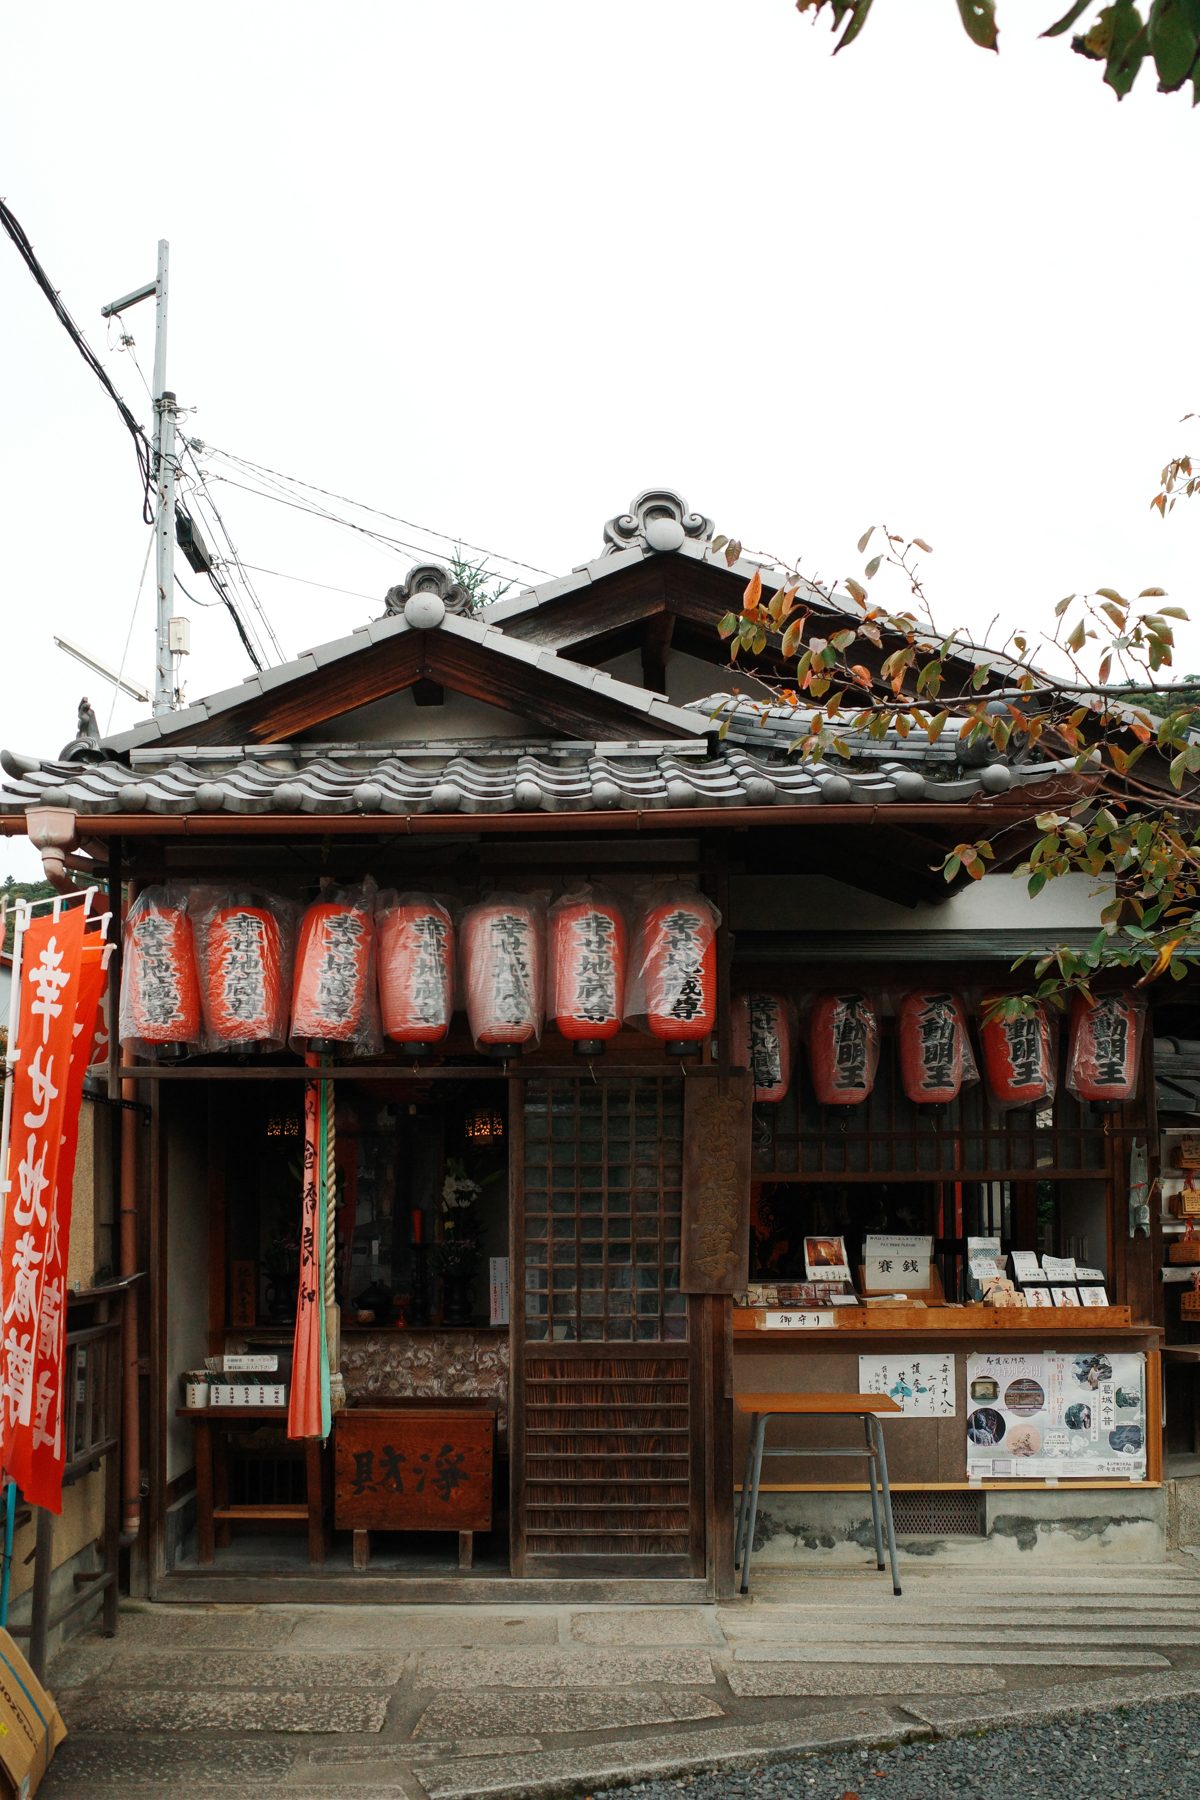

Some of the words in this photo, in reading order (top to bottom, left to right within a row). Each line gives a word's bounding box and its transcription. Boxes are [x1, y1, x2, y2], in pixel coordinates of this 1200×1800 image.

[223, 913, 266, 1022] 幸せ地蔵尊
[572, 911, 617, 1022] 幸せ地蔵尊
[660, 910, 706, 1022] 幸せ地蔵尊
[746, 995, 782, 1089] 幸せ地蔵尊
[832, 994, 874, 1090] 不動明王
[917, 994, 958, 1090] 不動明王
[1001, 1014, 1044, 1088] 動明王
[1088, 990, 1129, 1086] 不動明王
[878, 1259, 919, 1273] 賽銭
[779, 1314, 822, 1327] 御守り
[939, 1363, 954, 1414] 毎月十八日
[974, 1365, 1042, 1377] 秋の特別公開
[1101, 1384, 1114, 1426] 葛城今昔
